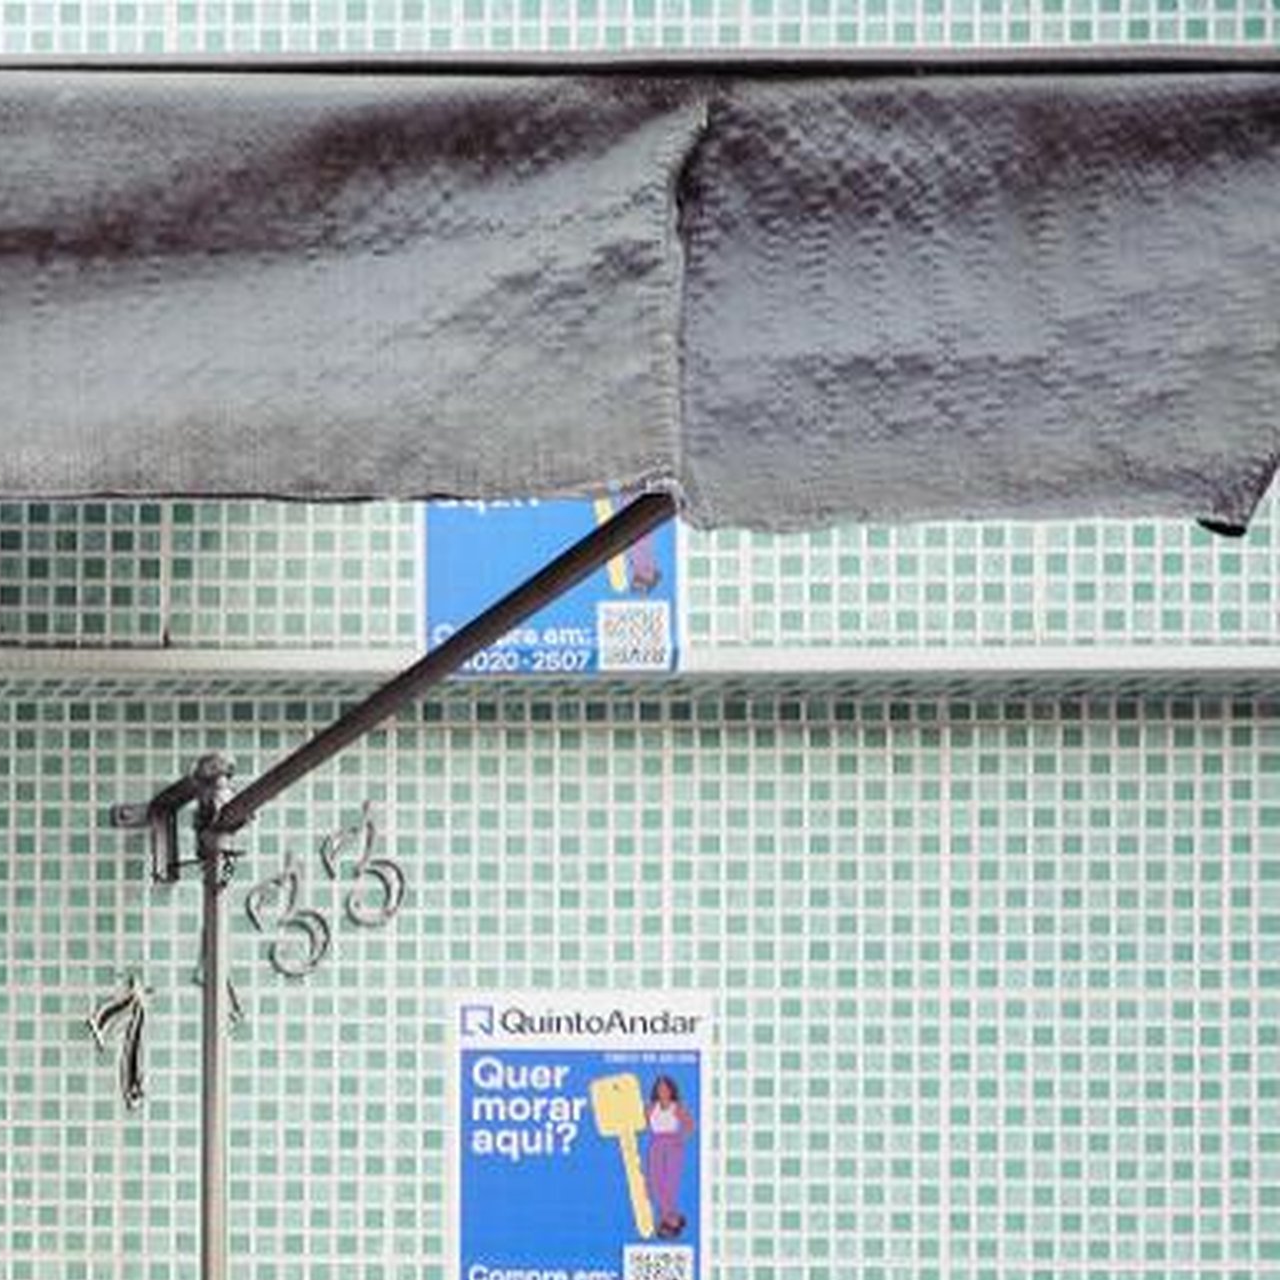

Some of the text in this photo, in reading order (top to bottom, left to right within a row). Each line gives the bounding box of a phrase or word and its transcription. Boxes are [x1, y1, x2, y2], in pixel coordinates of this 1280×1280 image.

[463, 650, 590, 671] 020-2507
[501, 1007, 700, 1036] QuintoAndar
[472, 1057, 570, 1089] Quer
[472, 1097, 587, 1122] morar
[472, 1123, 579, 1161] aqui?
